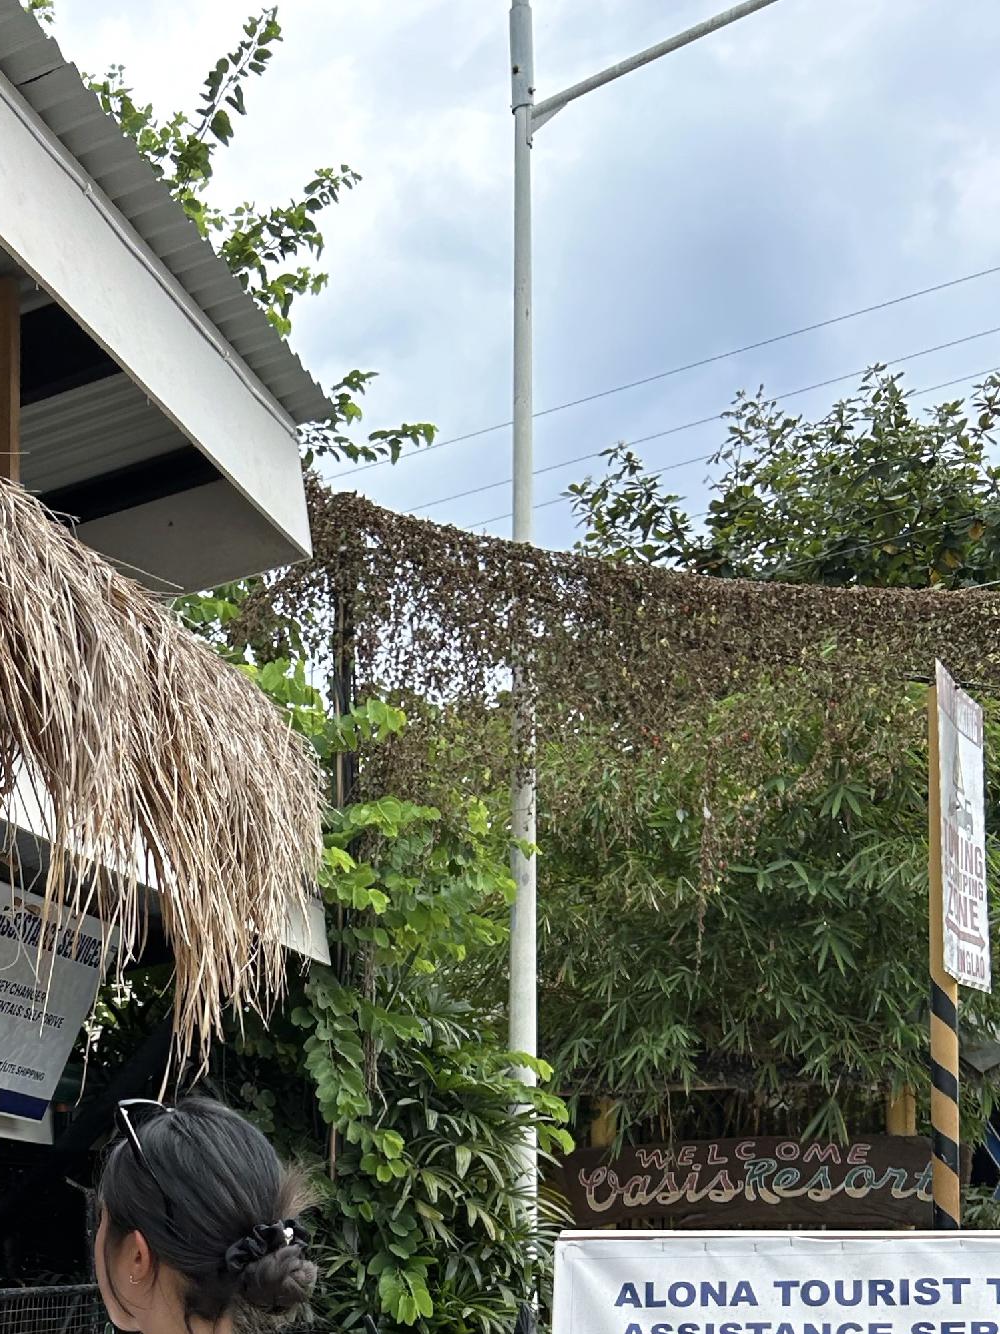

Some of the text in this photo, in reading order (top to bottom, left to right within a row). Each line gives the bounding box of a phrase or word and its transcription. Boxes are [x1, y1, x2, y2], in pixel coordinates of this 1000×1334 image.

[15, 1066, 46, 1082] SHIPPING
[614, 1280, 759, 1308] ALONA
[773, 1277, 971, 1307] TOURIST
